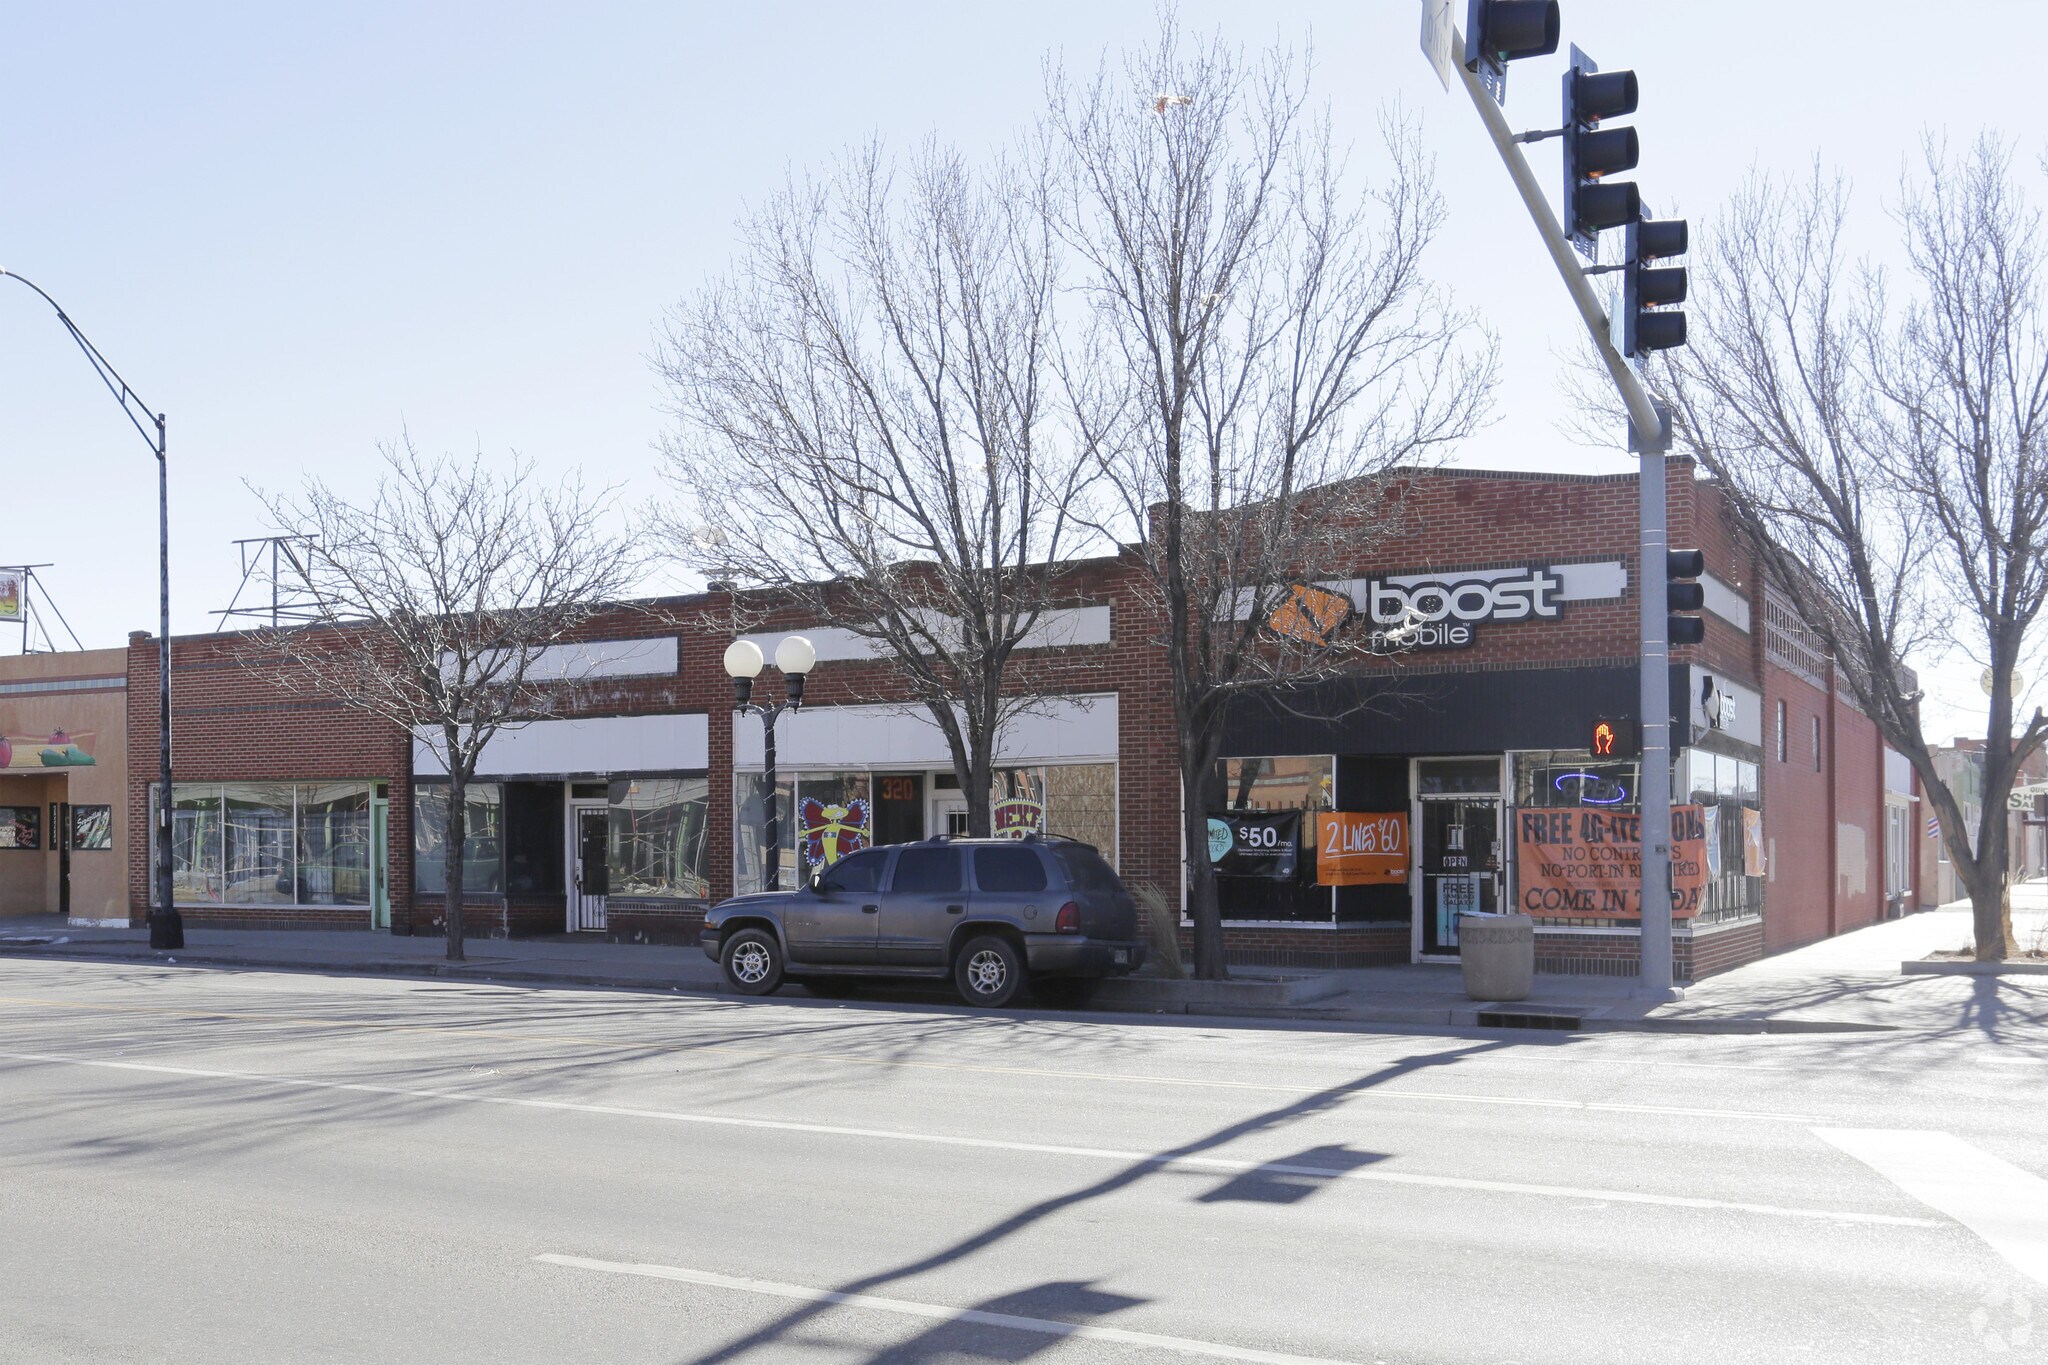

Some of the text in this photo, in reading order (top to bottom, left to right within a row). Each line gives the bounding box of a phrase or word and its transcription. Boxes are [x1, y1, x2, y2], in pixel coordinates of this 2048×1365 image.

[1371, 571, 1557, 624] boost
[882, 778, 914, 800] 320
[1562, 779, 1621, 799] OPEN
[1325, 818, 1400, 853] 2 LINES $60
[1522, 812, 1572, 845] FREE
[1580, 812, 1641, 844] 4G-LTE
[1443, 856, 1468, 867] OPEN
[1562, 847, 1586, 861] NO
[1589, 845, 1681, 861] CONTRS
[1541, 863, 1563, 878] NO
[1566, 864, 1624, 878] PORT-IN
[1443, 883, 1475, 894] FREE
[1525, 887, 1596, 911] COME
[1601, 888, 1629, 911] IN
